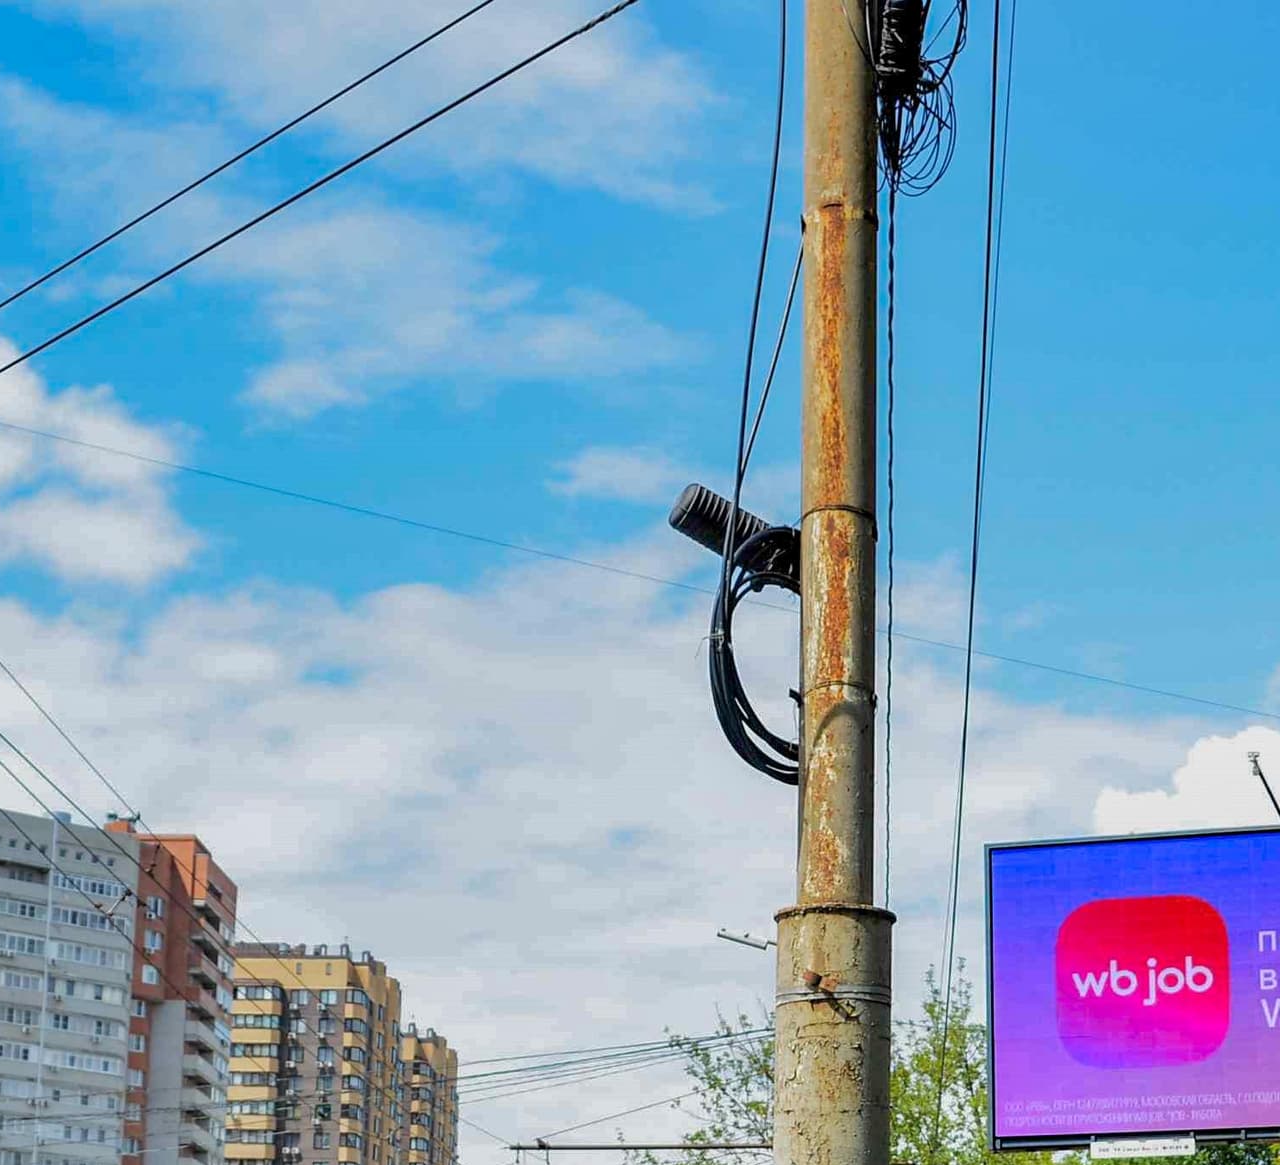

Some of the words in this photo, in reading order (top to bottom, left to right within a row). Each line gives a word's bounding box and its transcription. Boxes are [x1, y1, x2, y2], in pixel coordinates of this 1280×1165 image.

[1072, 959, 1138, 998] wb
[1143, 955, 1214, 1007] job
[1260, 968, 1278, 990] в
